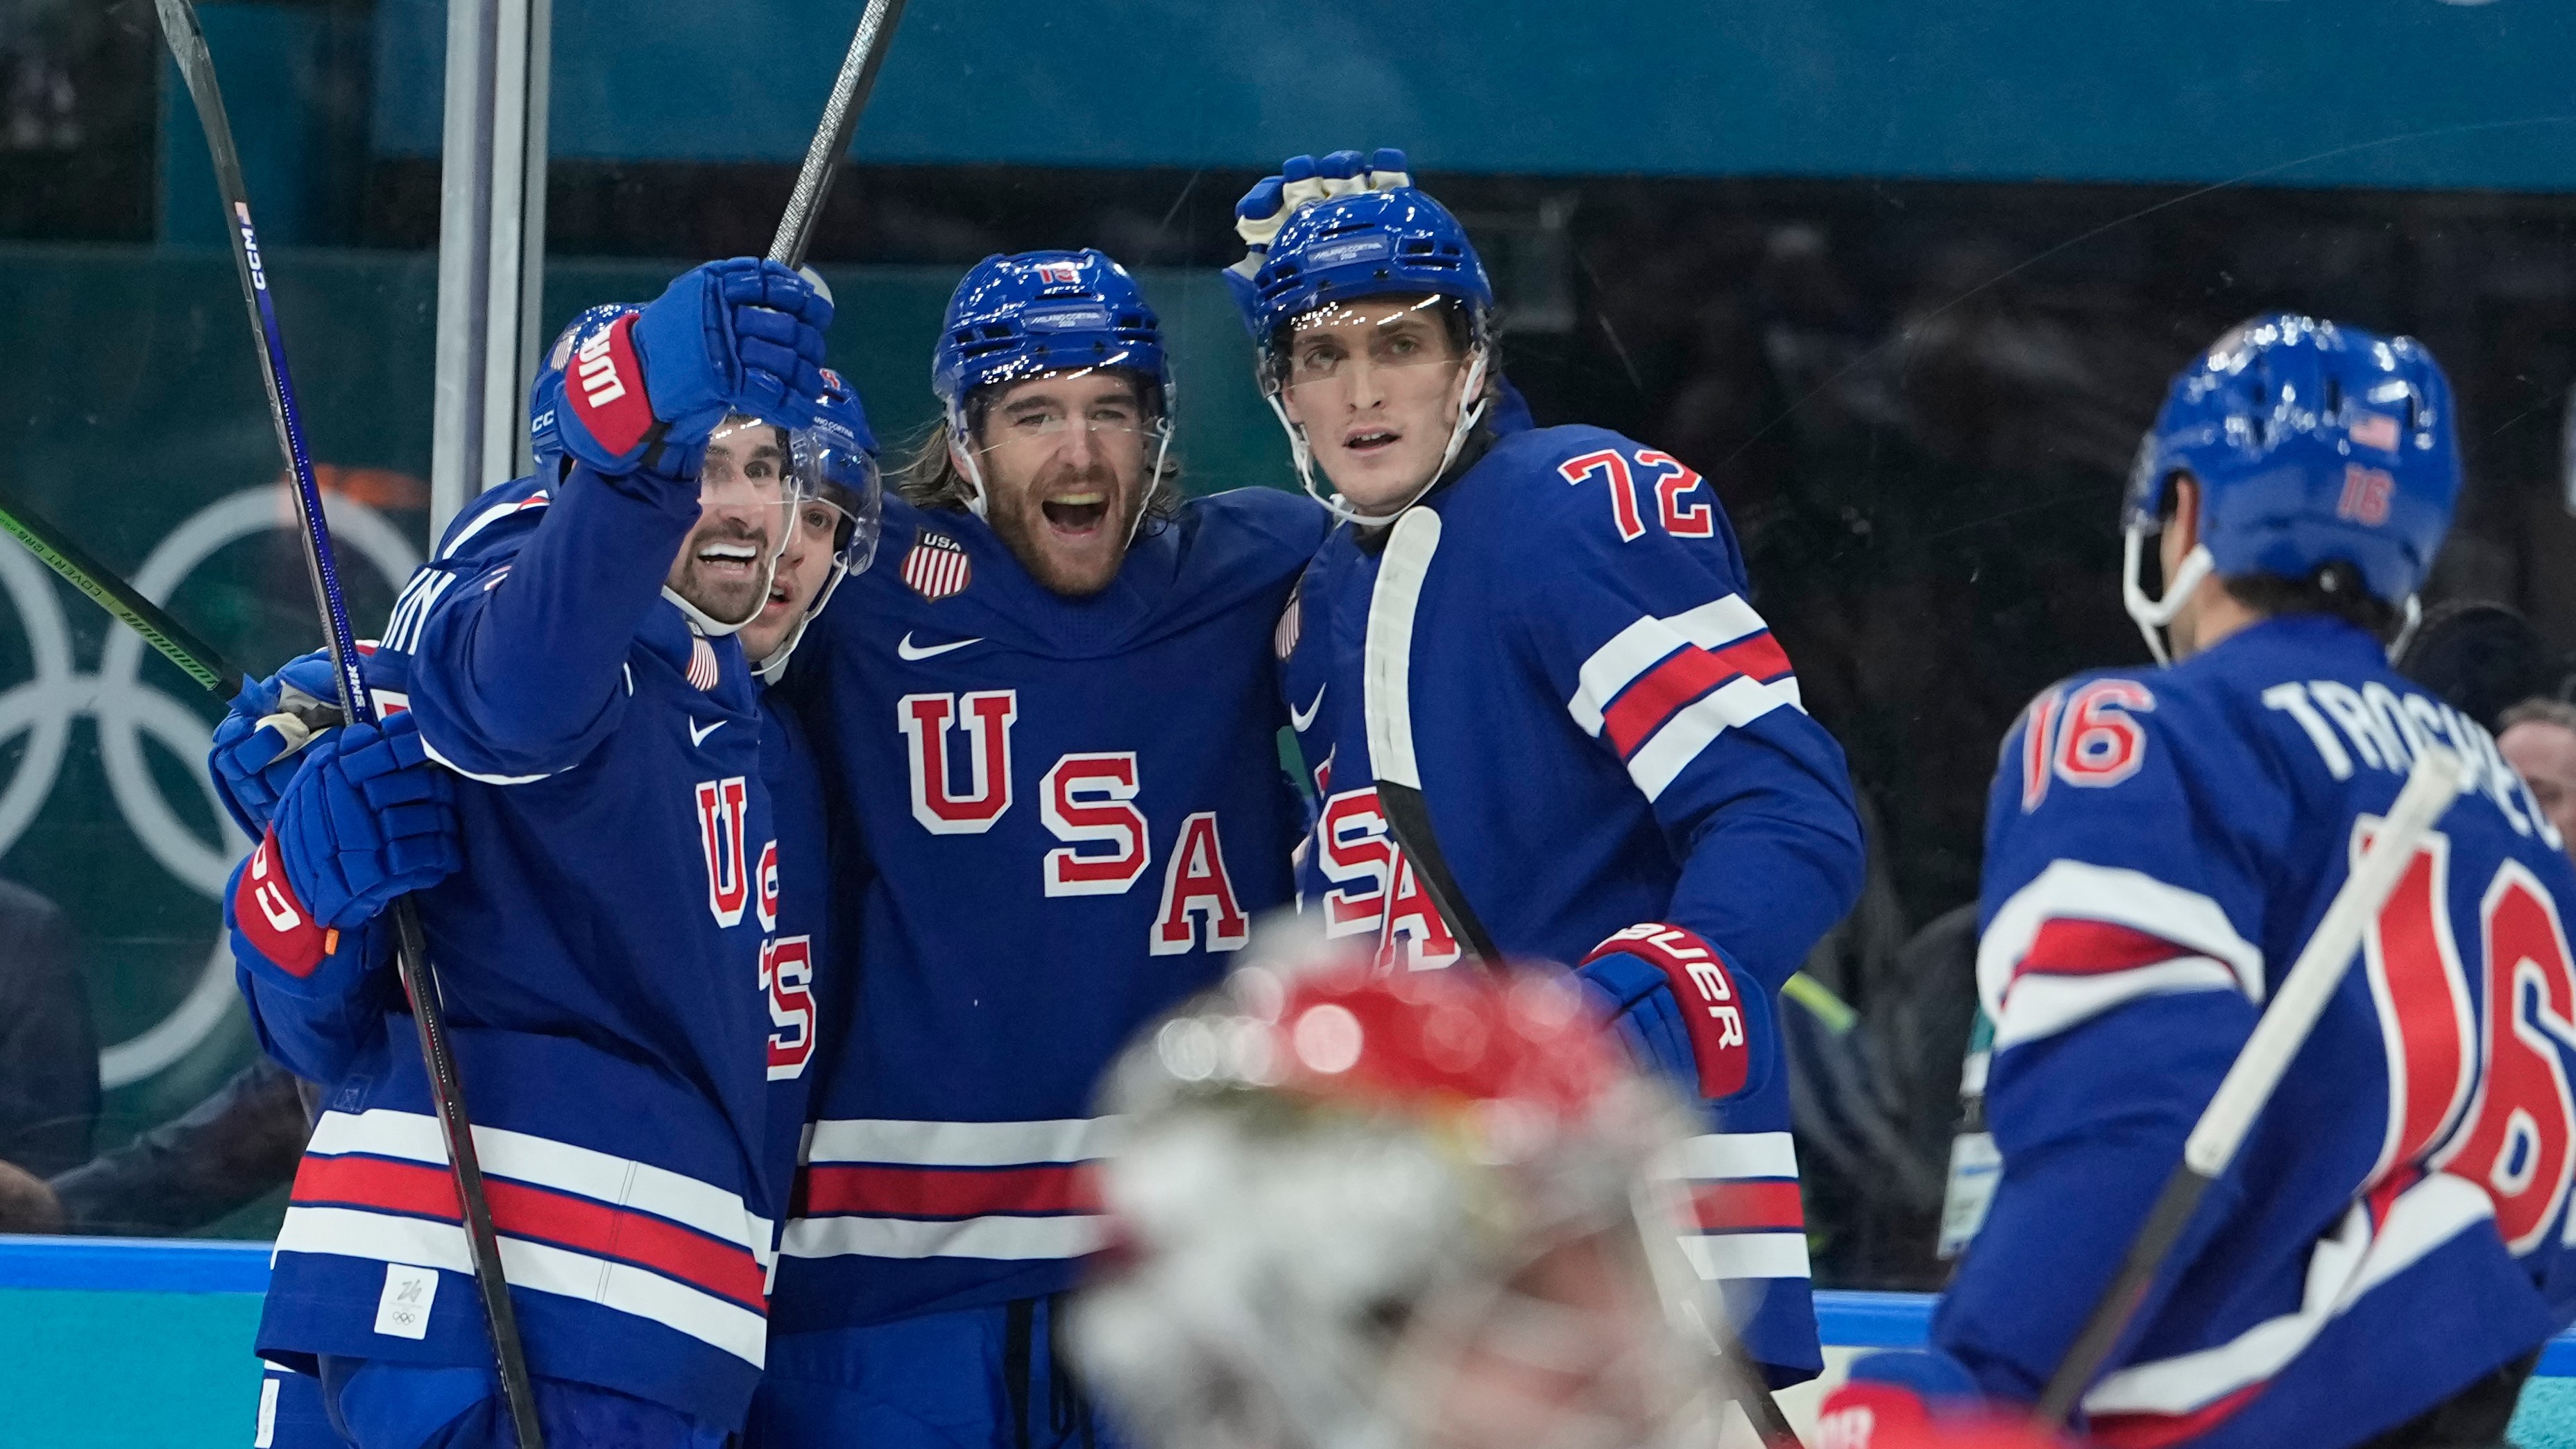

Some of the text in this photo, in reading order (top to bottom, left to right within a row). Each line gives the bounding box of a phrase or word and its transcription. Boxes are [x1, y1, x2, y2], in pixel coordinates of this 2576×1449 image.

[241, 228, 266, 291] CCM
[531, 410, 555, 434] CC
[1558, 447, 1714, 543] 72
[2337, 461, 2394, 527] 16
[47, 554, 103, 597] COVERT
[923, 532, 962, 553] USA
[2022, 677, 2156, 815] 16
[897, 689, 1250, 957] USA
[1313, 749, 1462, 973] SA
[251, 840, 301, 933] CC
[1590, 923, 1744, 1051] AUER
[2350, 812, 2576, 1259] 16
